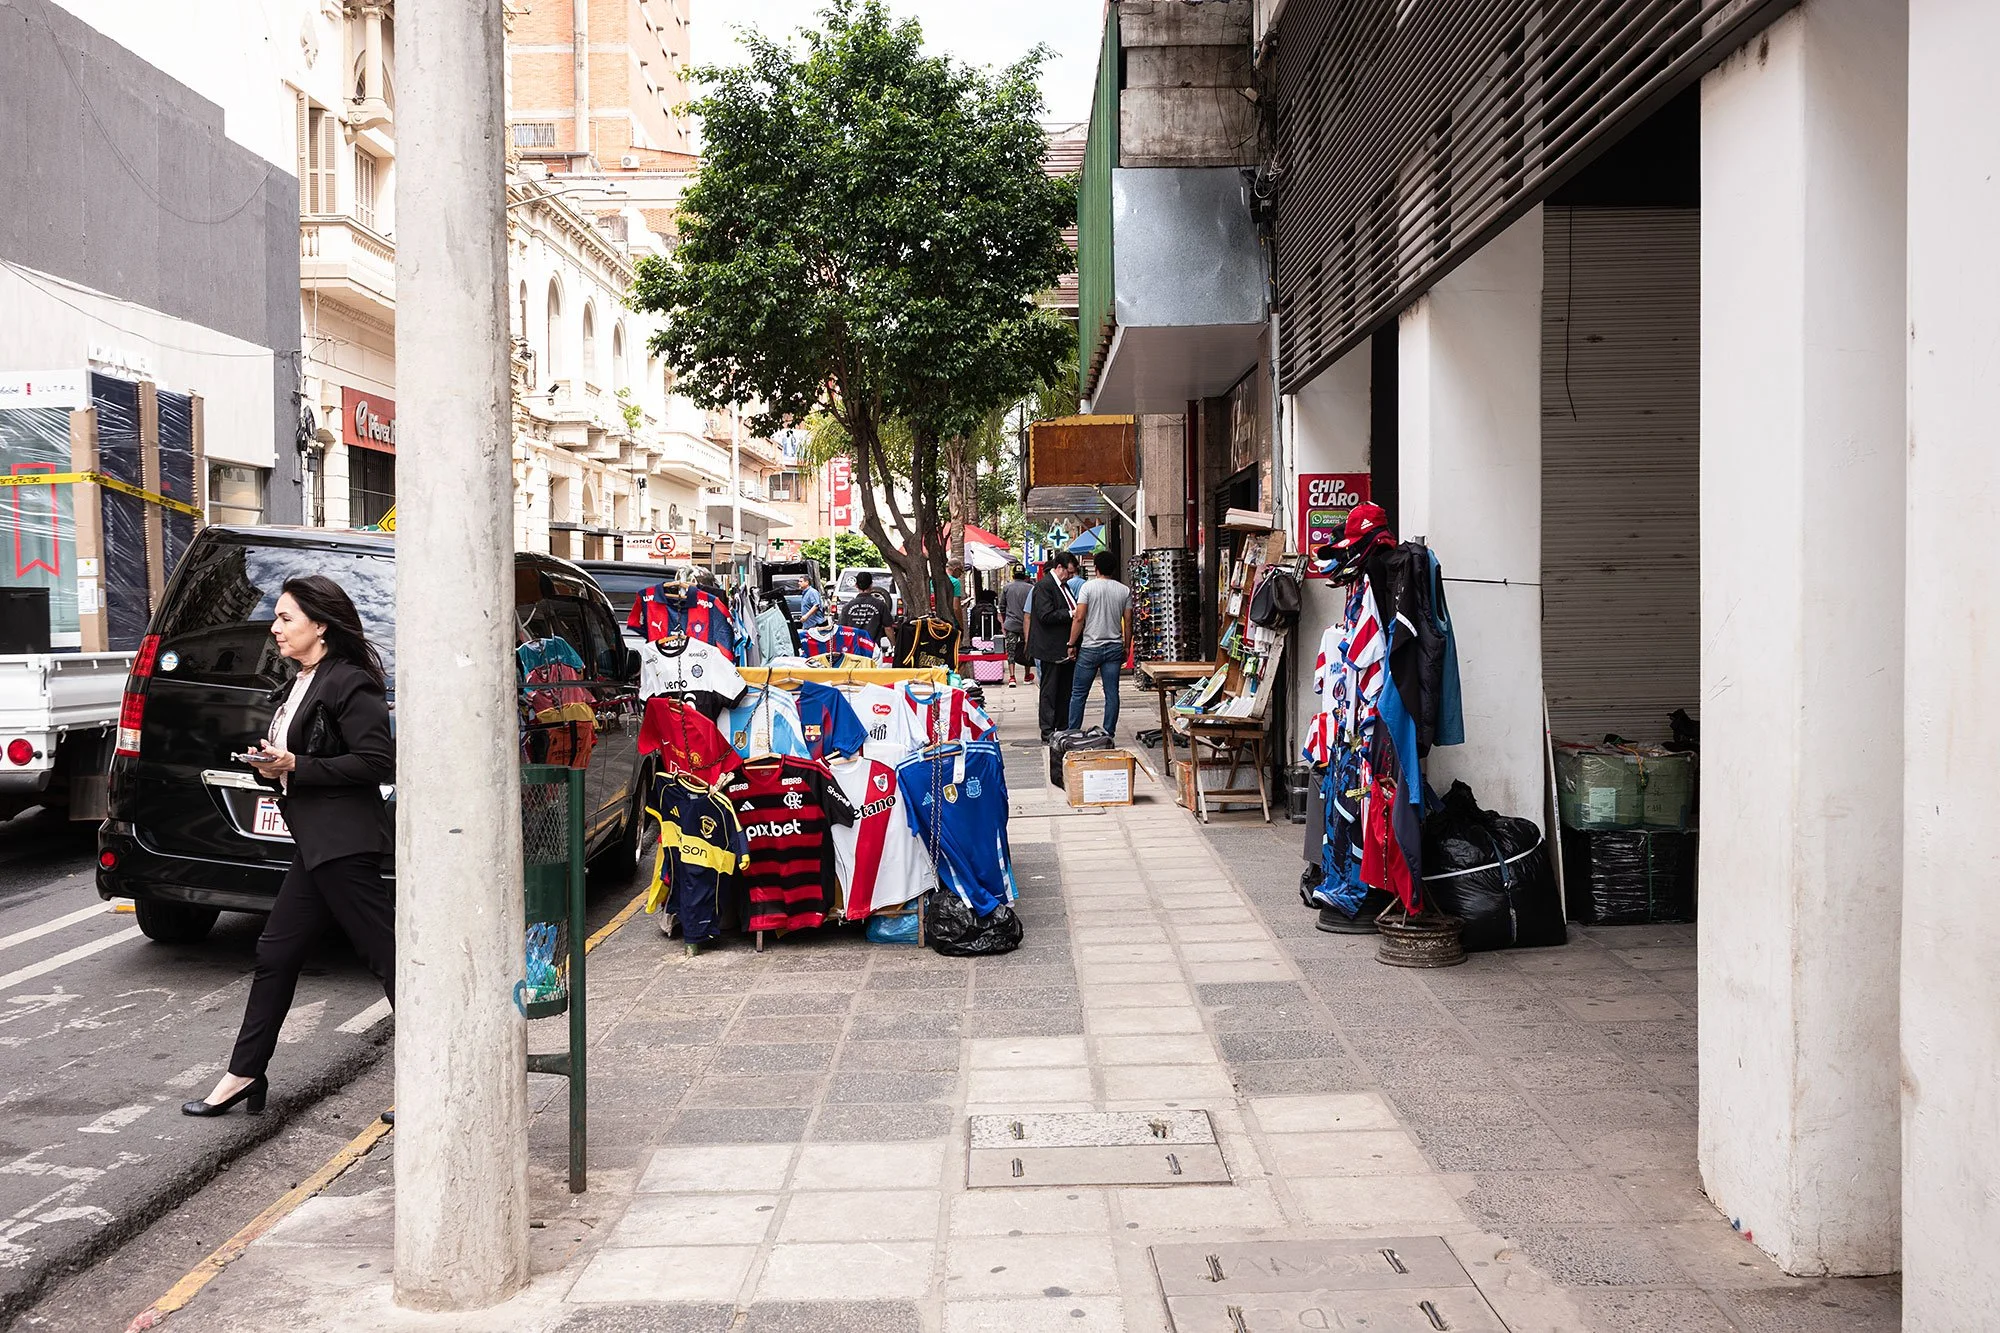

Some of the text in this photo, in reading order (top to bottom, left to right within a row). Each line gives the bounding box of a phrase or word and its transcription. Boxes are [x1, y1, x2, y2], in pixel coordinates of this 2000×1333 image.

[1308, 479, 1345, 493] CHIP
[1308, 492, 1359, 506] CLARO
[827, 785, 851, 807] Shopee
[852, 795, 897, 821] etano
